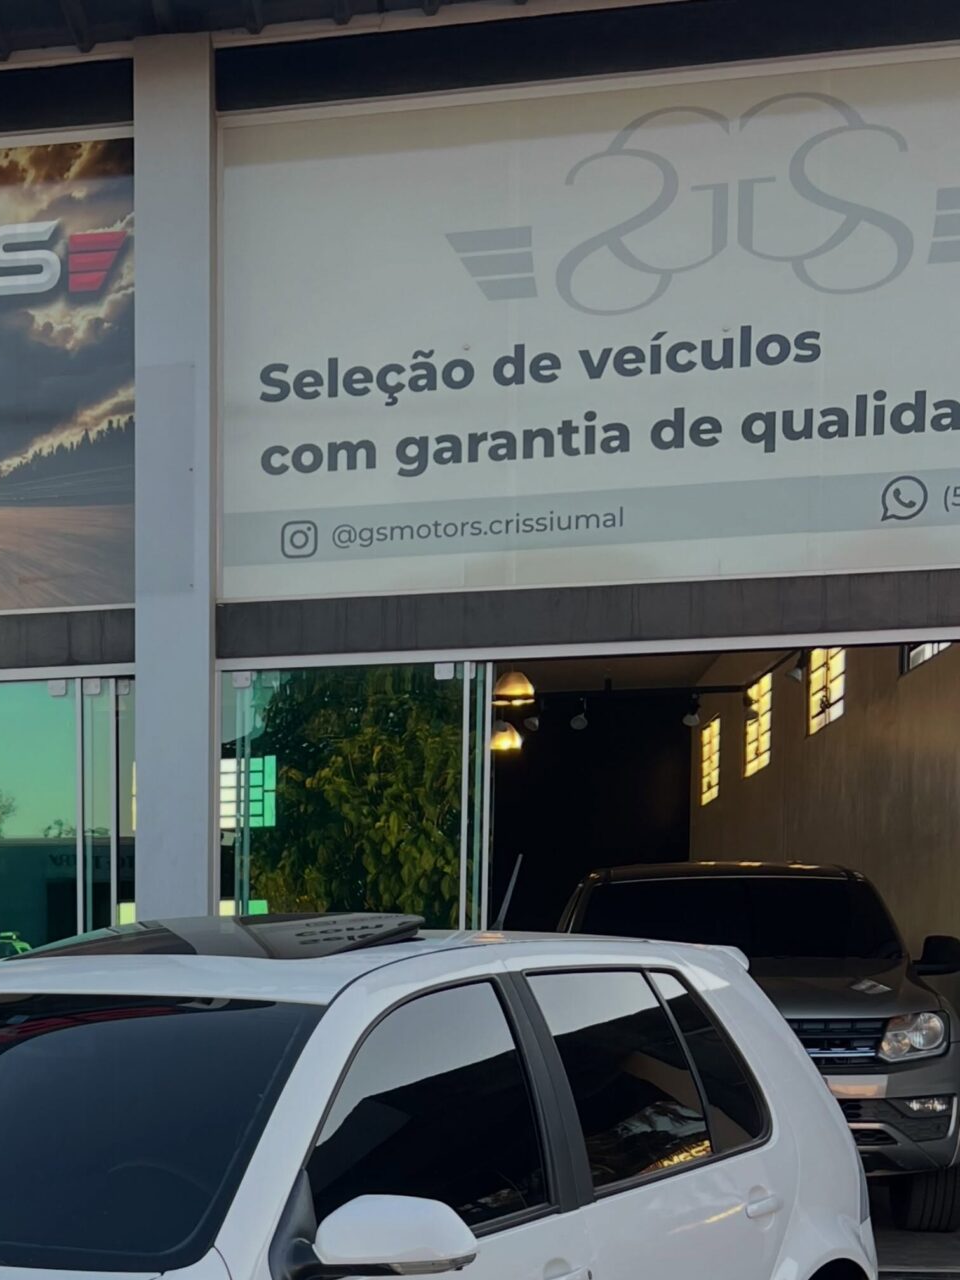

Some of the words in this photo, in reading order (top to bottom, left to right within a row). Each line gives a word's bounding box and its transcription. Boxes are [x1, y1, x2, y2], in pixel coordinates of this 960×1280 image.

[259, 348, 476, 408] Seleção
[492, 343, 562, 387] de
[577, 324, 822, 381] veículos
[260, 439, 377, 476] com
[395, 409, 631, 478] garantia
[649, 406, 723, 451] de
[331, 505, 625, 550] @gsmotors.crissiumal
